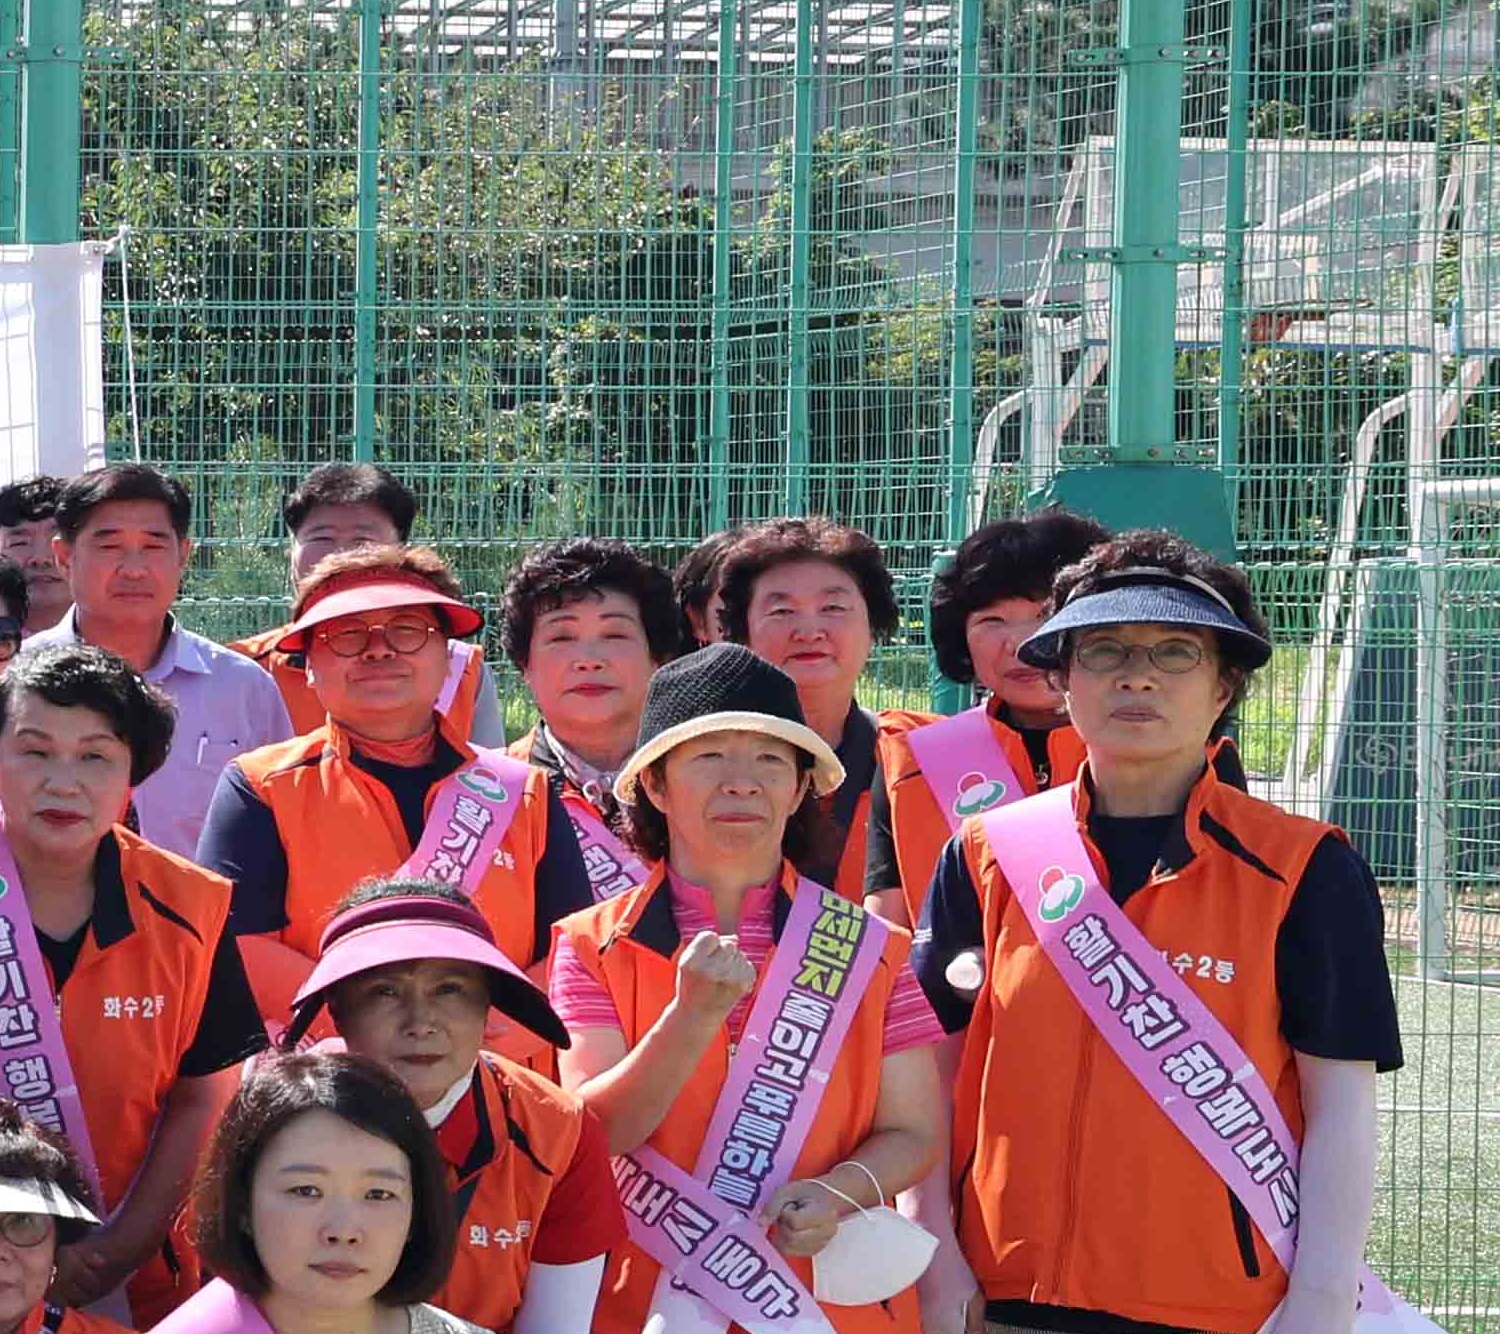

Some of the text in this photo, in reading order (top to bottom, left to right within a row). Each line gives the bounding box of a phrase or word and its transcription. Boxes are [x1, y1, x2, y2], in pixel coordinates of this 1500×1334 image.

[1061, 913, 1191, 1051] 활기찬
[755, 989, 832, 1090] 줄이고
[701, 1234, 800, 1320] 동구
